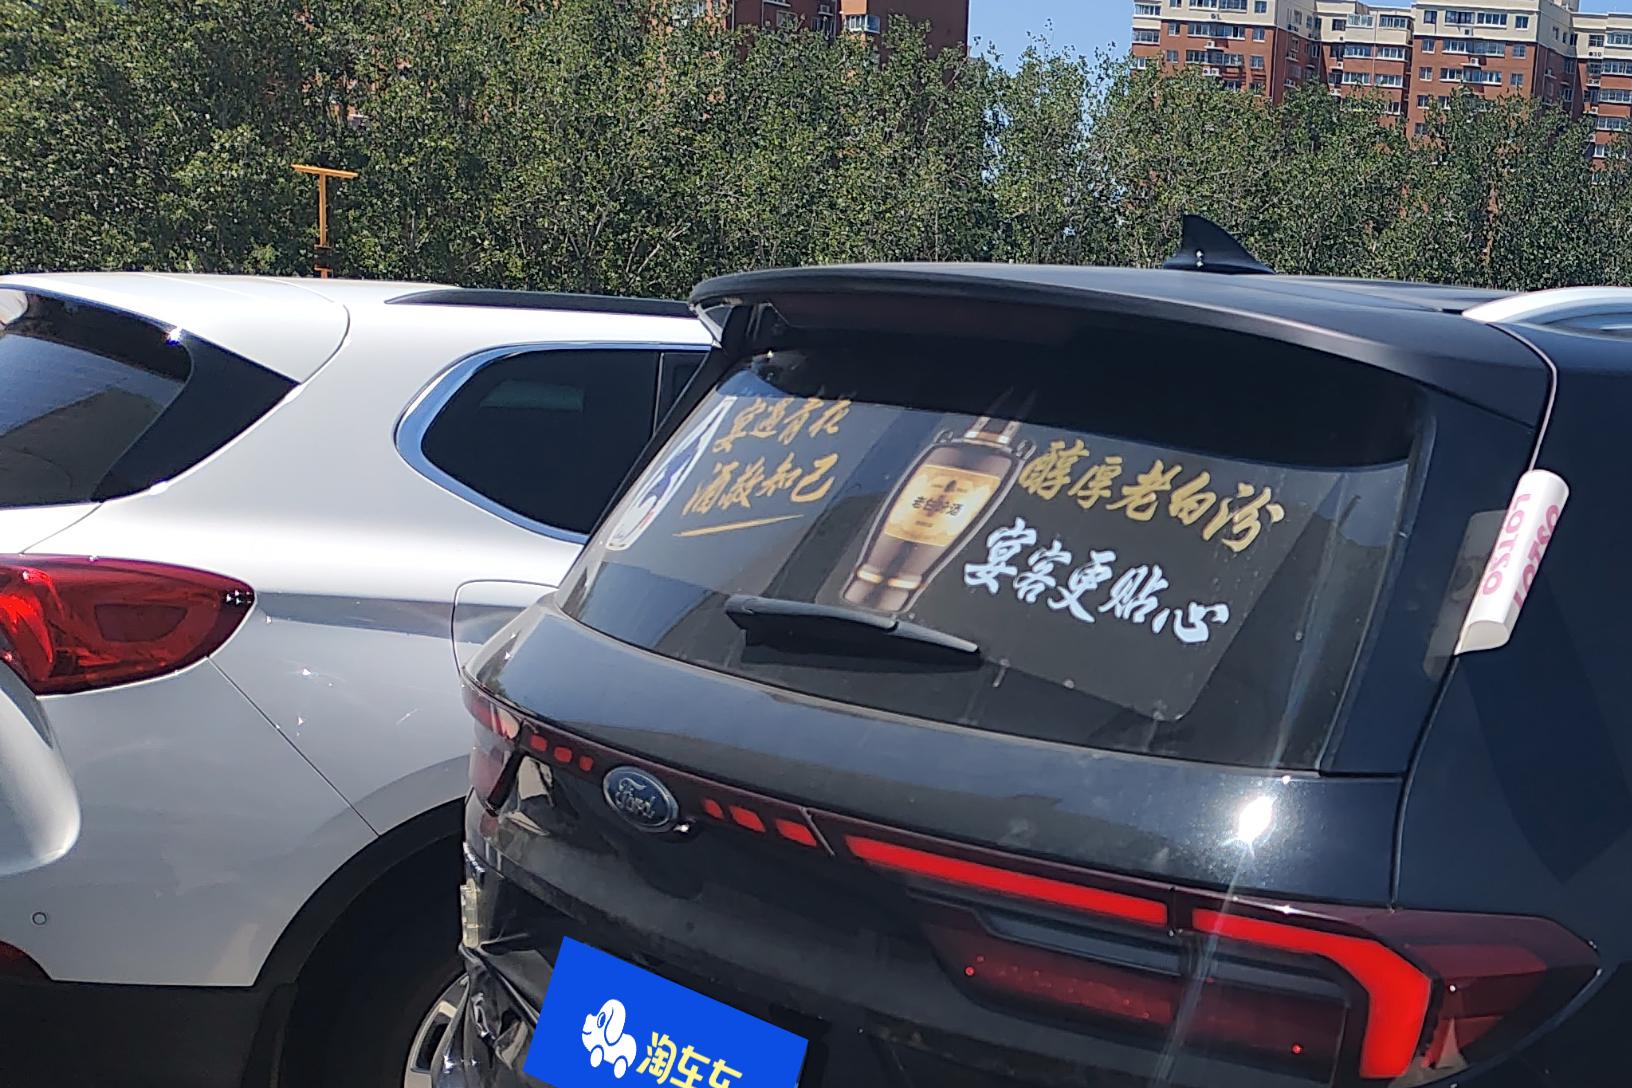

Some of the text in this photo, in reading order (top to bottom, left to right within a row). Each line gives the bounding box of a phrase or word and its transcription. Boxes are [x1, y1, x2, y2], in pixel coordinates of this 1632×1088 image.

[1018, 438, 1285, 552] 醇厚老白汾
[963, 517, 1230, 643] 宴客更贴心
[614, 777, 657, 819] Ford
